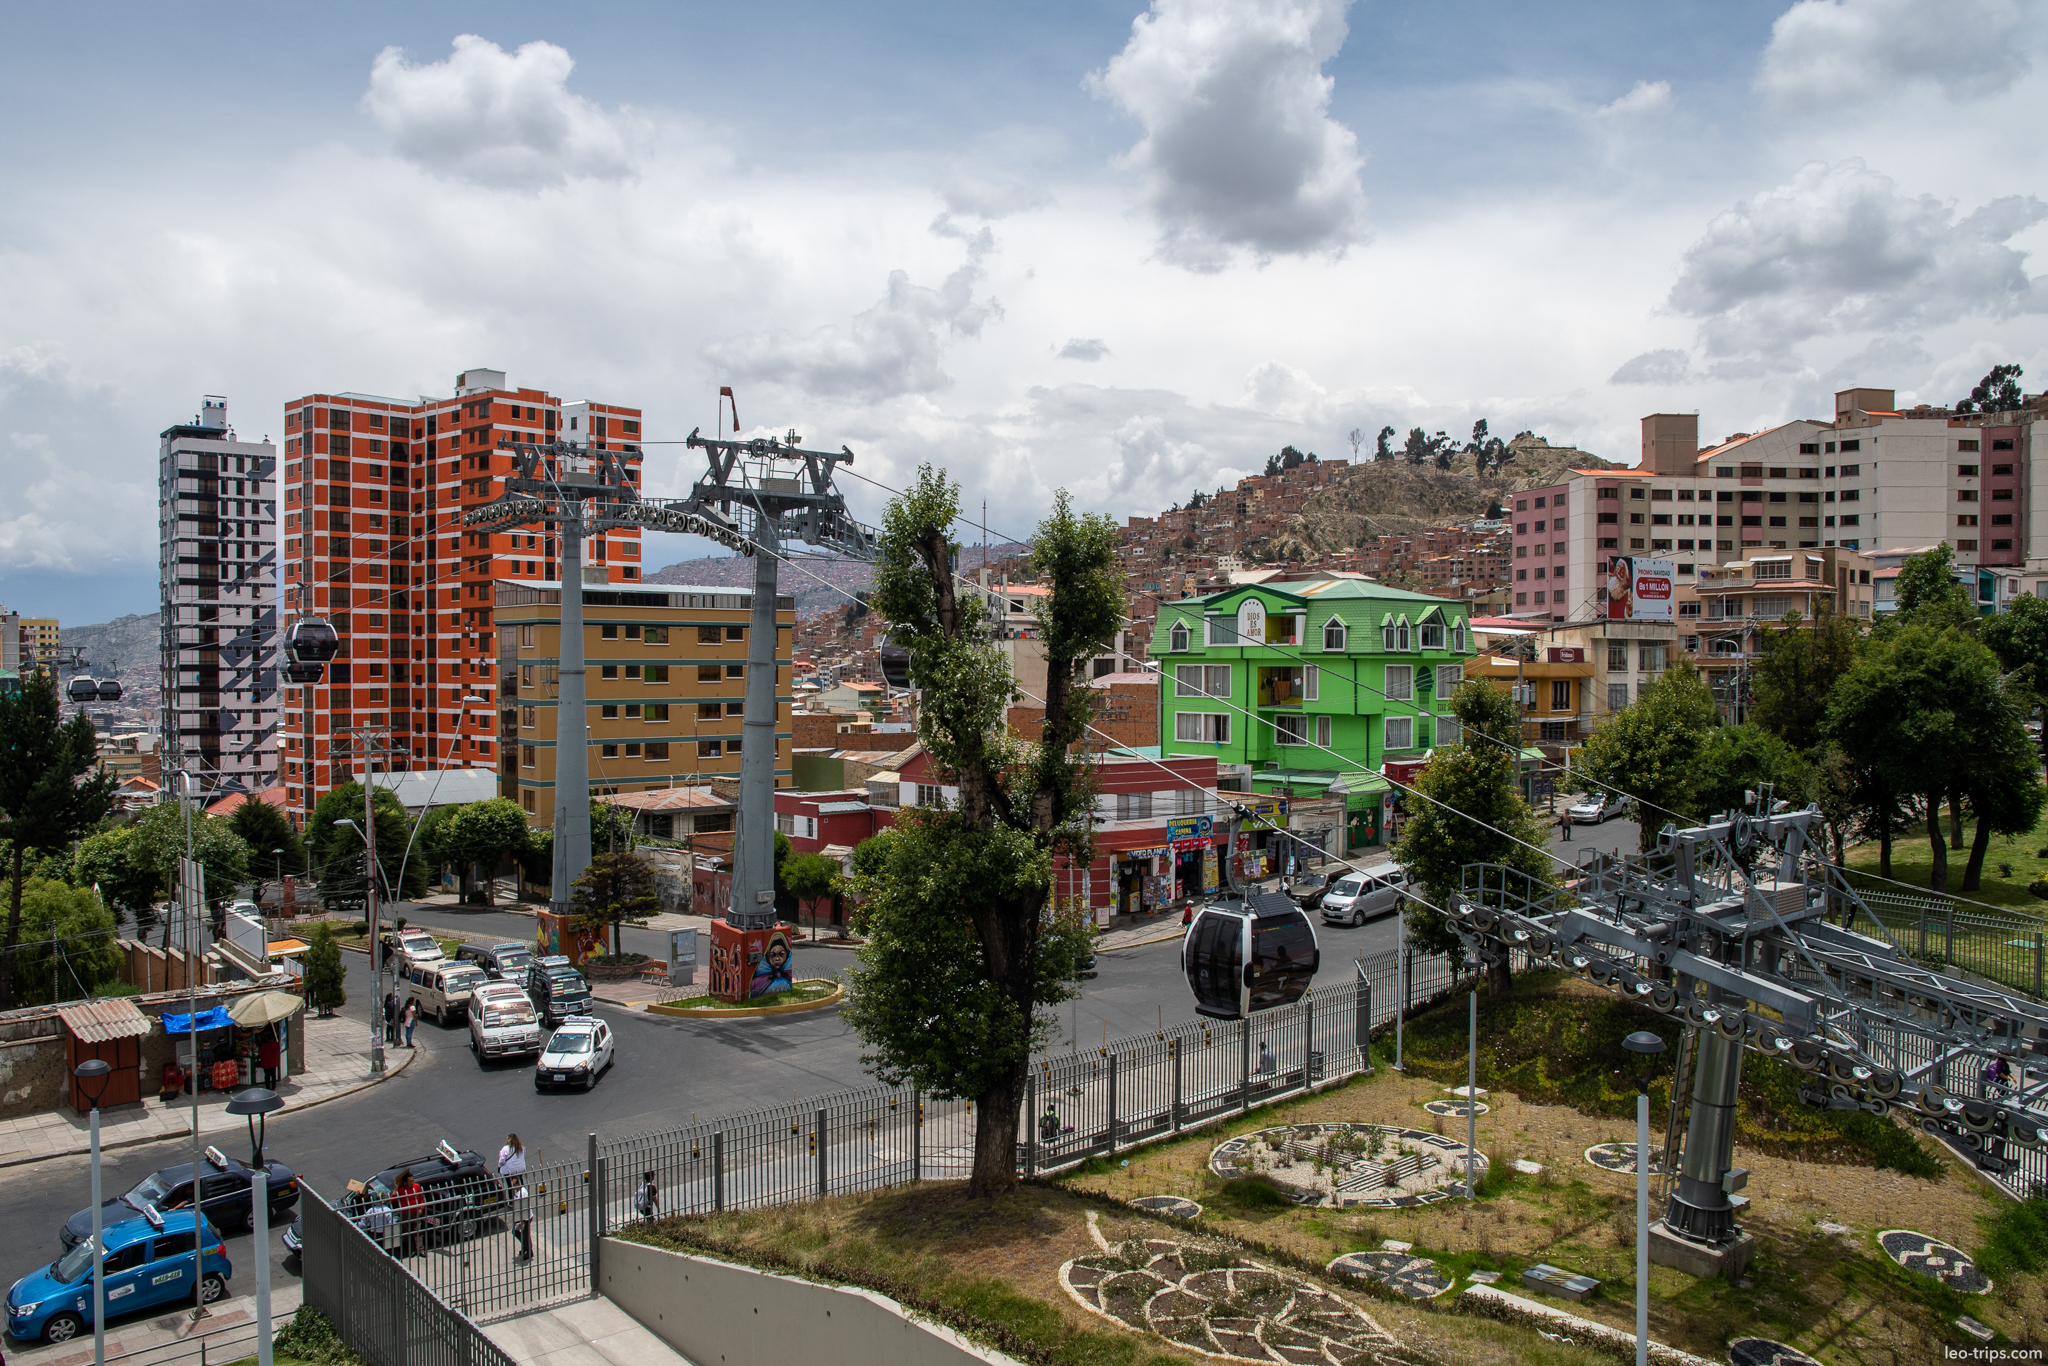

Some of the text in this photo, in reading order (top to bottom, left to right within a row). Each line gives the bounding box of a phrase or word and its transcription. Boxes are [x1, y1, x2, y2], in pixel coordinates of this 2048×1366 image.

[1649, 581, 1669, 591] MILLÓN
[1246, 612, 1260, 620] DIOS
[1246, 628, 1262, 636] AMOR
[1168, 818, 1197, 827] PELUQUERIA
